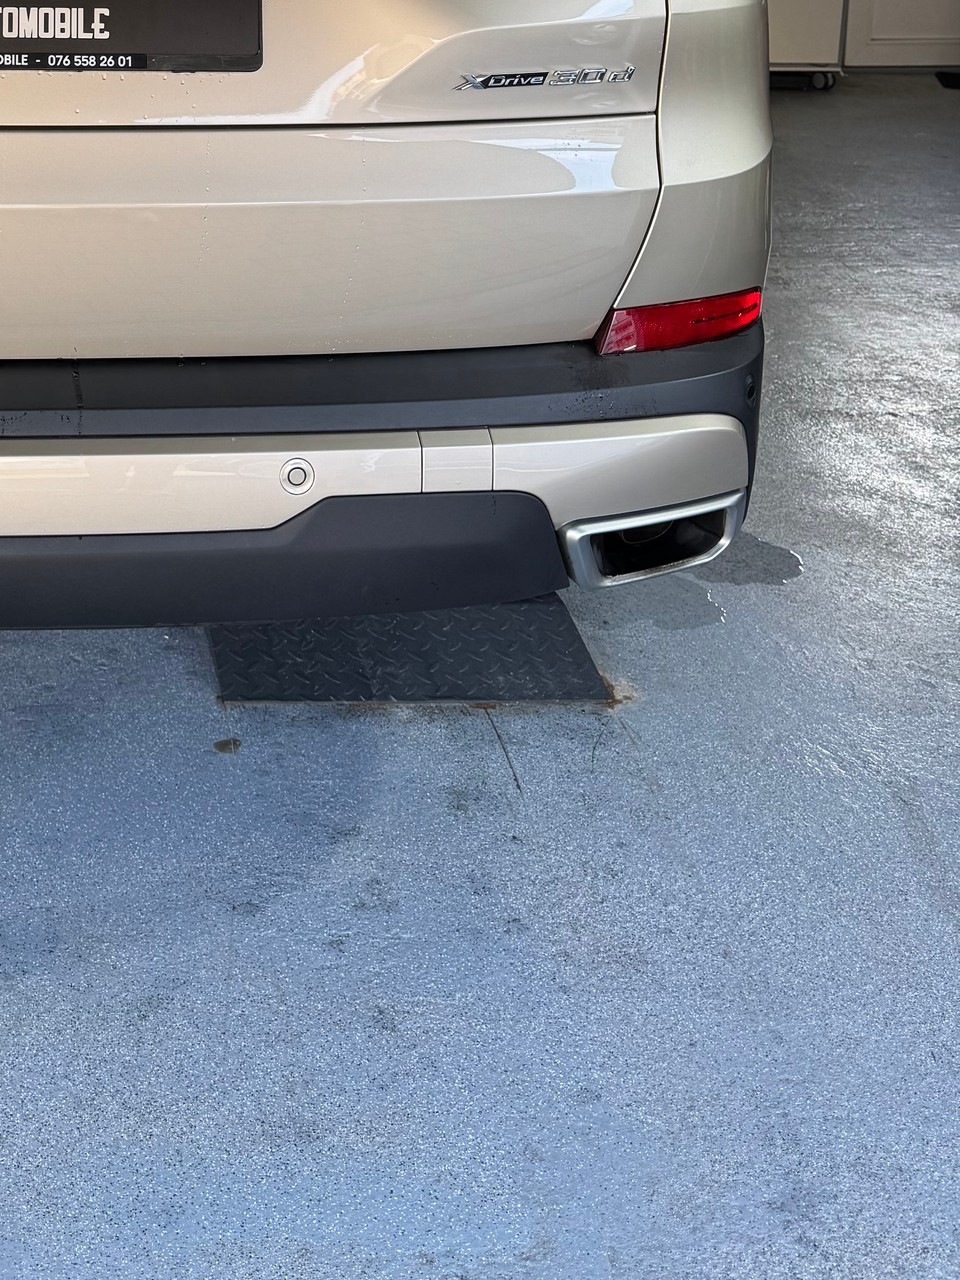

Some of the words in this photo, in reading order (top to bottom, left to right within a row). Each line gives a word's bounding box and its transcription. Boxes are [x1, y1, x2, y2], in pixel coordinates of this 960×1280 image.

[47, 54, 71, 67] 076
[73, 55, 96, 67] 558
[99, 55, 115, 67] 26
[117, 55, 132, 67] 01
